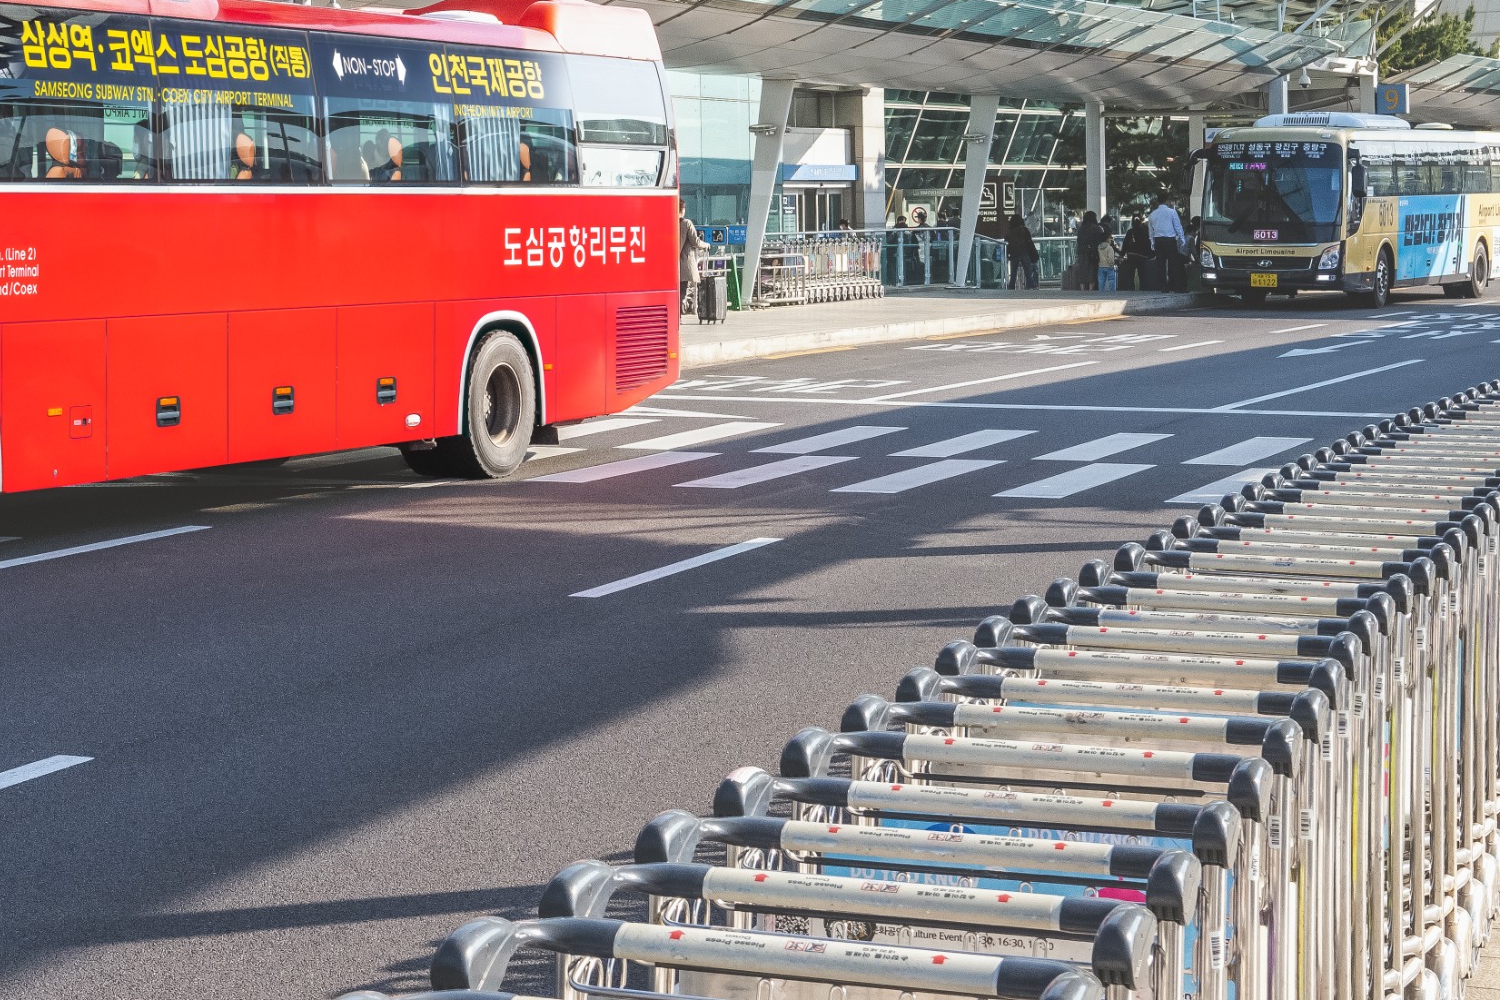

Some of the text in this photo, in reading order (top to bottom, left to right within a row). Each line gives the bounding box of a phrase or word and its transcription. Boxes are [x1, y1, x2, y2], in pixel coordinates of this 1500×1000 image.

[343, 57, 397, 77] NON-STOP
[429, 52, 545, 99] 인천국제공항
[34, 81, 93, 99] SAMSEONG
[96, 84, 134, 100] SUBWAY
[193, 87, 214, 104] CITY
[216, 89, 251, 106] AIRPORT
[254, 91, 294, 108] TERMINAL
[1385, 89, 1399, 110] 9
[453, 103, 487, 117] INCHEON
[506, 106, 533, 119] AIRPORT
[1254, 230, 1277, 239] 6013
[5, 247, 26, 262] (Line
[27, 247, 37, 261] 2)
[503, 224, 646, 268] 도심공항리무진
[7, 264, 40, 278] Terminal
[939, 931, 962, 942] Event
[998, 937, 1026, 949] 16:30,
